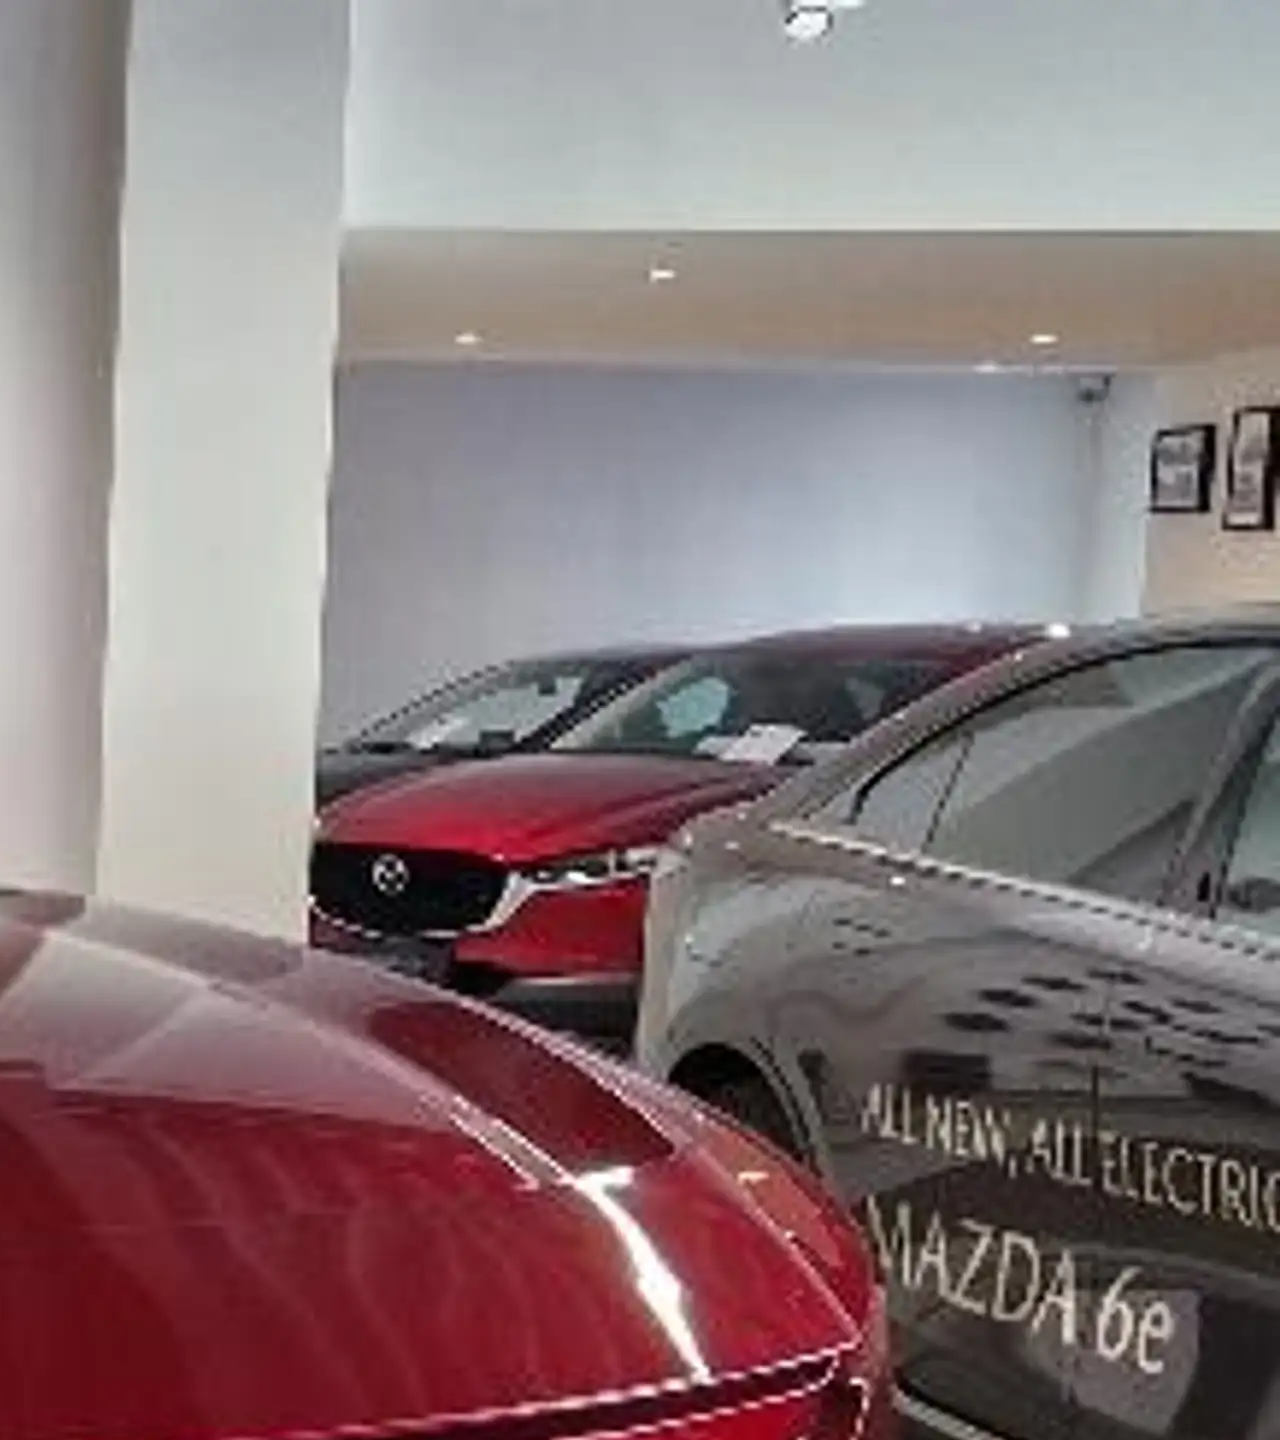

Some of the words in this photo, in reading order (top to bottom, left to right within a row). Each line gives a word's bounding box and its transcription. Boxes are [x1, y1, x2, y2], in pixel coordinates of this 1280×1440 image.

[860, 1082, 918, 1146] ALL
[1025, 1117, 1093, 1186] ALL
[1095, 1265, 1174, 1375] 6e
